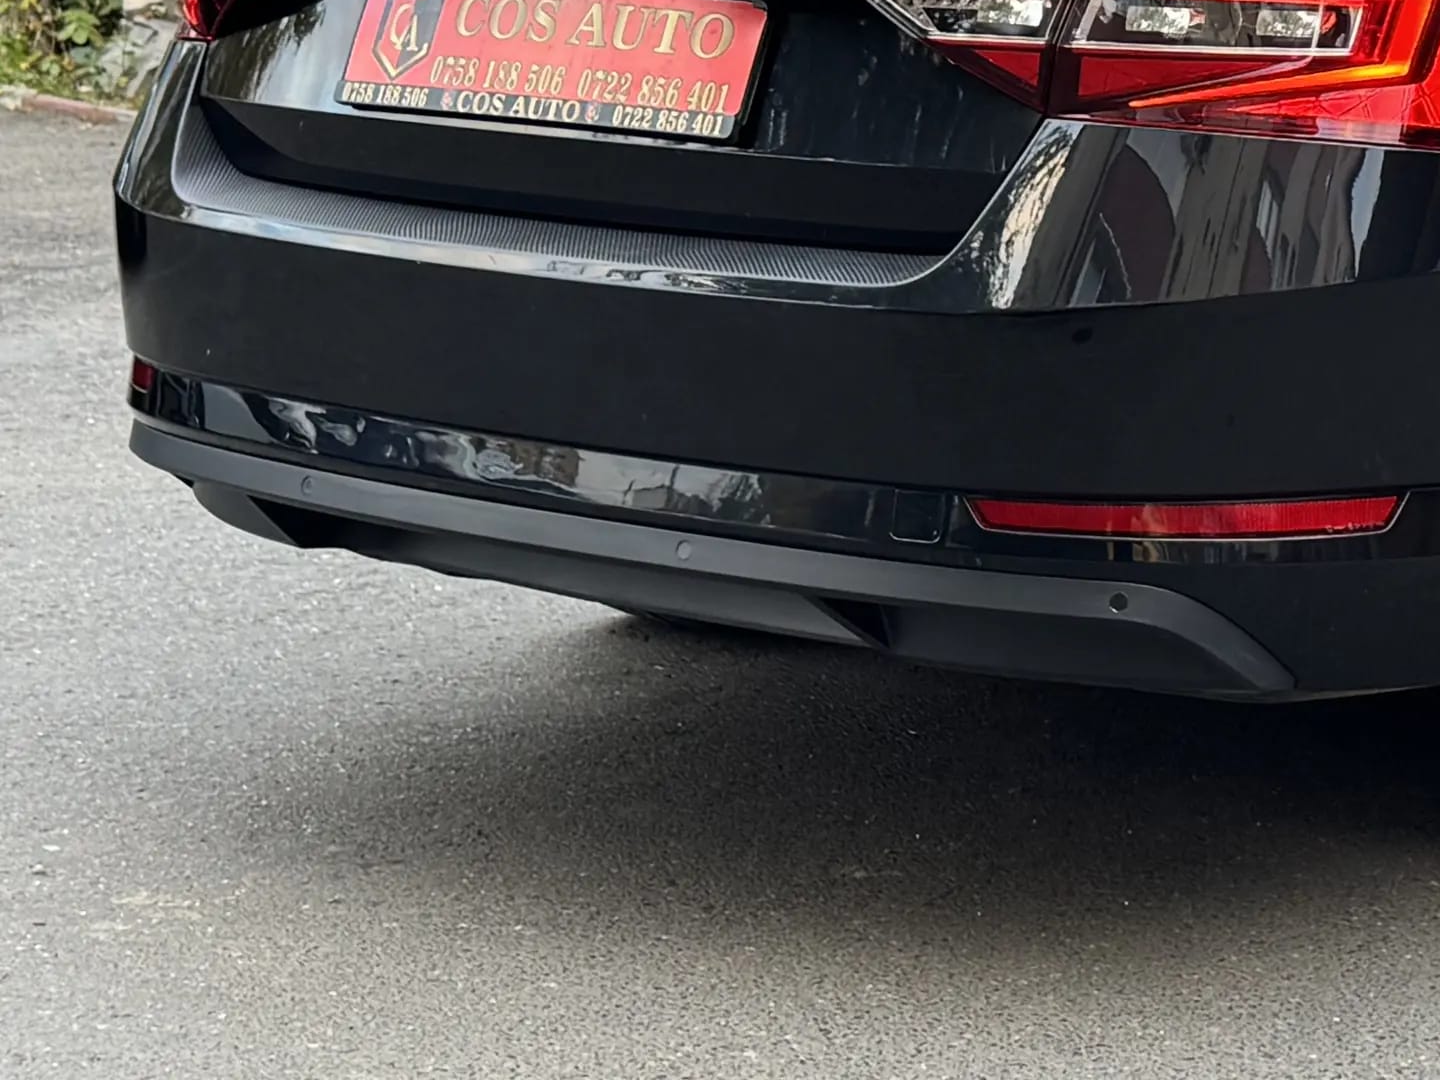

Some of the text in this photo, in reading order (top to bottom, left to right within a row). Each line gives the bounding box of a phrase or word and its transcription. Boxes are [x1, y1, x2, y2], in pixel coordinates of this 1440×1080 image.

[566, 3, 736, 60] AUTO
[342, 82, 723, 136] 0758 188 506 COS AUTO 0722 856 401
[430, 56, 729, 113] 0758 188 506 0722 856 401
